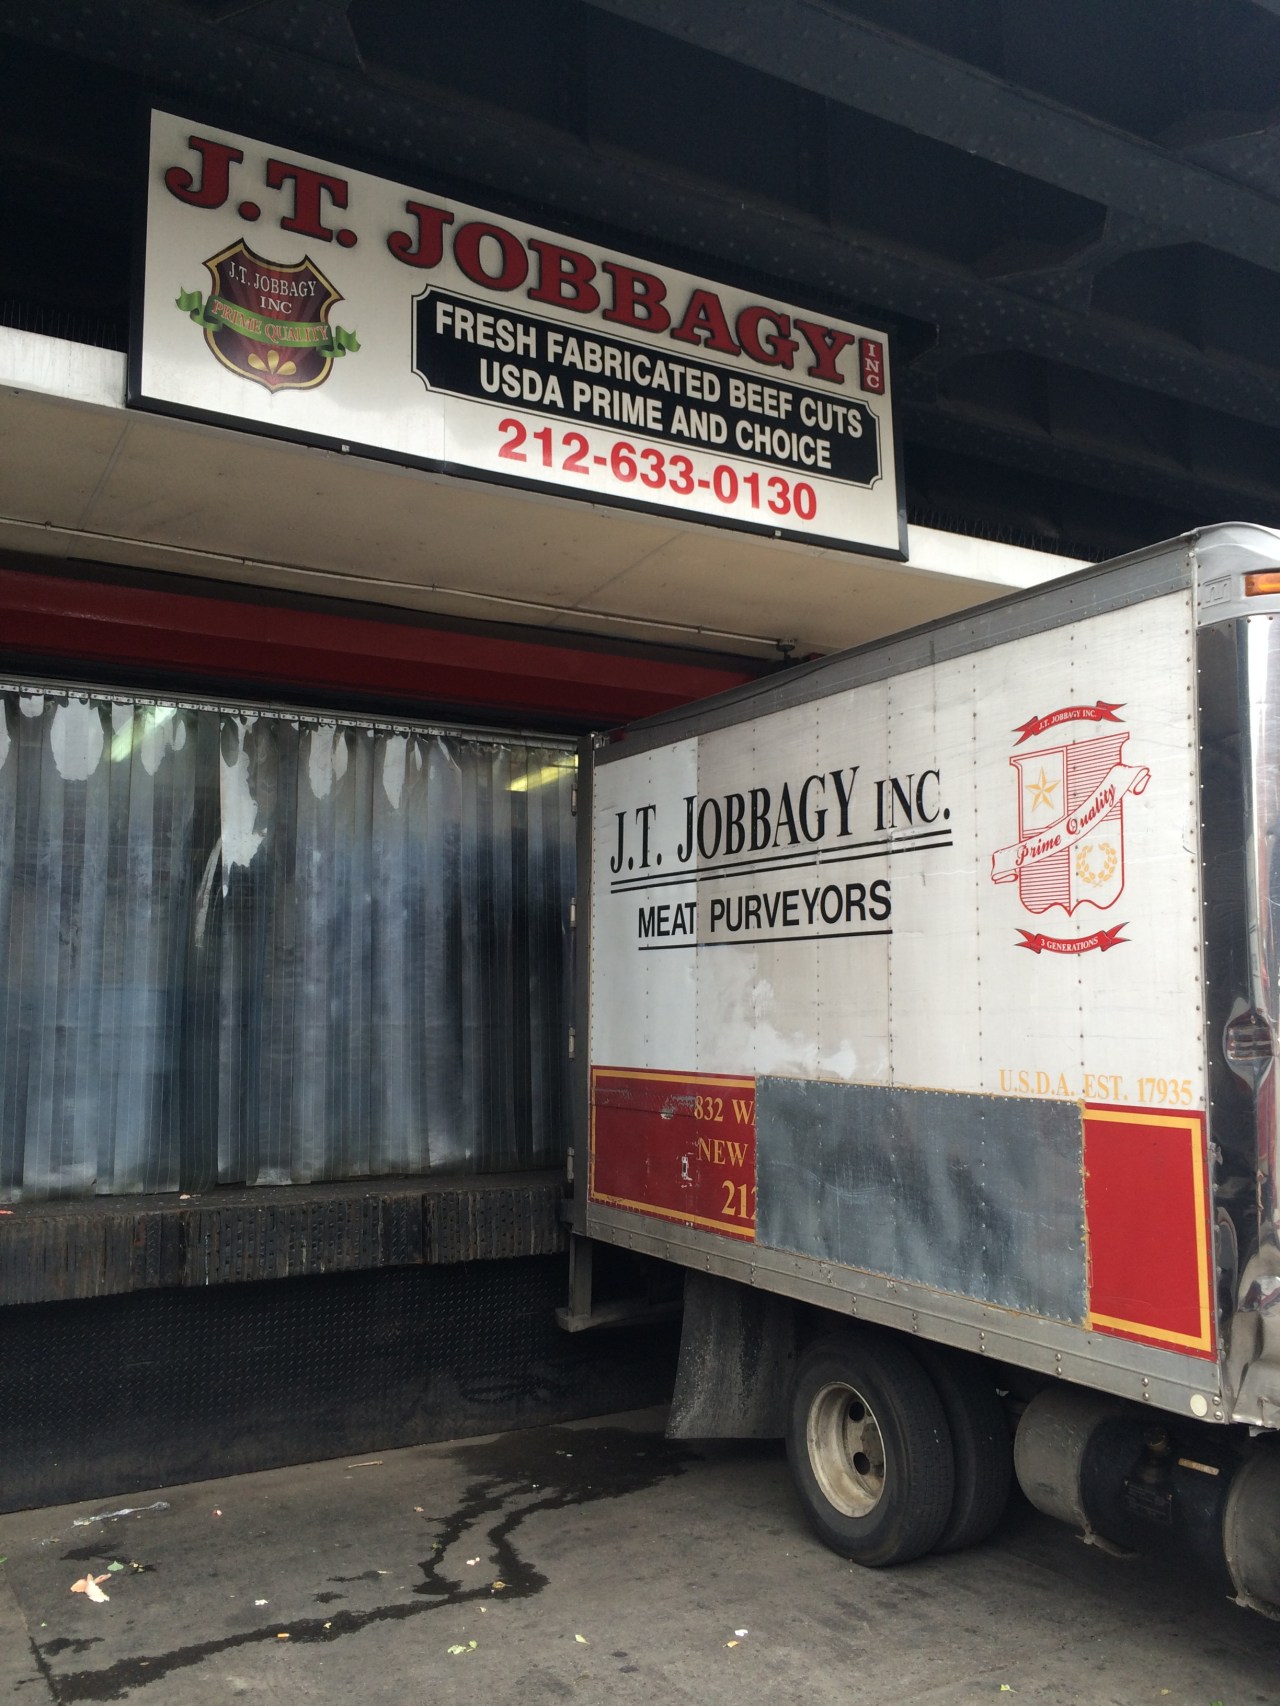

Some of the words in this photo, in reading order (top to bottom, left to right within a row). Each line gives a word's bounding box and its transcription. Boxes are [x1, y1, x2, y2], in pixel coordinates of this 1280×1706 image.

[164, 135, 358, 248] J.T.
[387, 200, 855, 385] JOBBAGY
[865, 343, 880, 388] INC
[228, 261, 250, 286] J.T.
[253, 273, 317, 297] JOBBAGY
[211, 299, 262, 335] PRIME
[264, 323, 328, 344] QUALITY
[260, 296, 292, 314] INC
[436, 301, 537, 359] FRESH
[547, 331, 721, 402] FABRICATED
[729, 378, 793, 420] BEEF
[800, 396, 863, 439] CUTS
[480, 358, 564, 408] USDA
[573, 380, 663, 431] PRIME
[670, 405, 728, 445] AND
[735, 419, 832, 470] CHOICE
[498, 418, 817, 521] 212-633-0130
[1051, 709, 1081, 724] JOBBAGY
[610, 804, 662, 874] J.T.
[677, 765, 860, 863] JOBBAGY
[874, 768, 951, 832] INC.
[1015, 835, 1062, 867] Prime
[1066, 784, 1116, 835] Quality
[638, 902, 697, 938] MEAT
[710, 879, 892, 932] PURVEYORS
[1047, 936, 1098, 951] GENERATIONS
[1000, 1069, 1074, 1097] U.S.D.A.
[1083, 1073, 1128, 1100] EST.
[1137, 1076, 1193, 1105] 17935
[694, 1095, 724, 1122] 832
[732, 1098, 756, 1126] W
[698, 1136, 749, 1168] NEW
